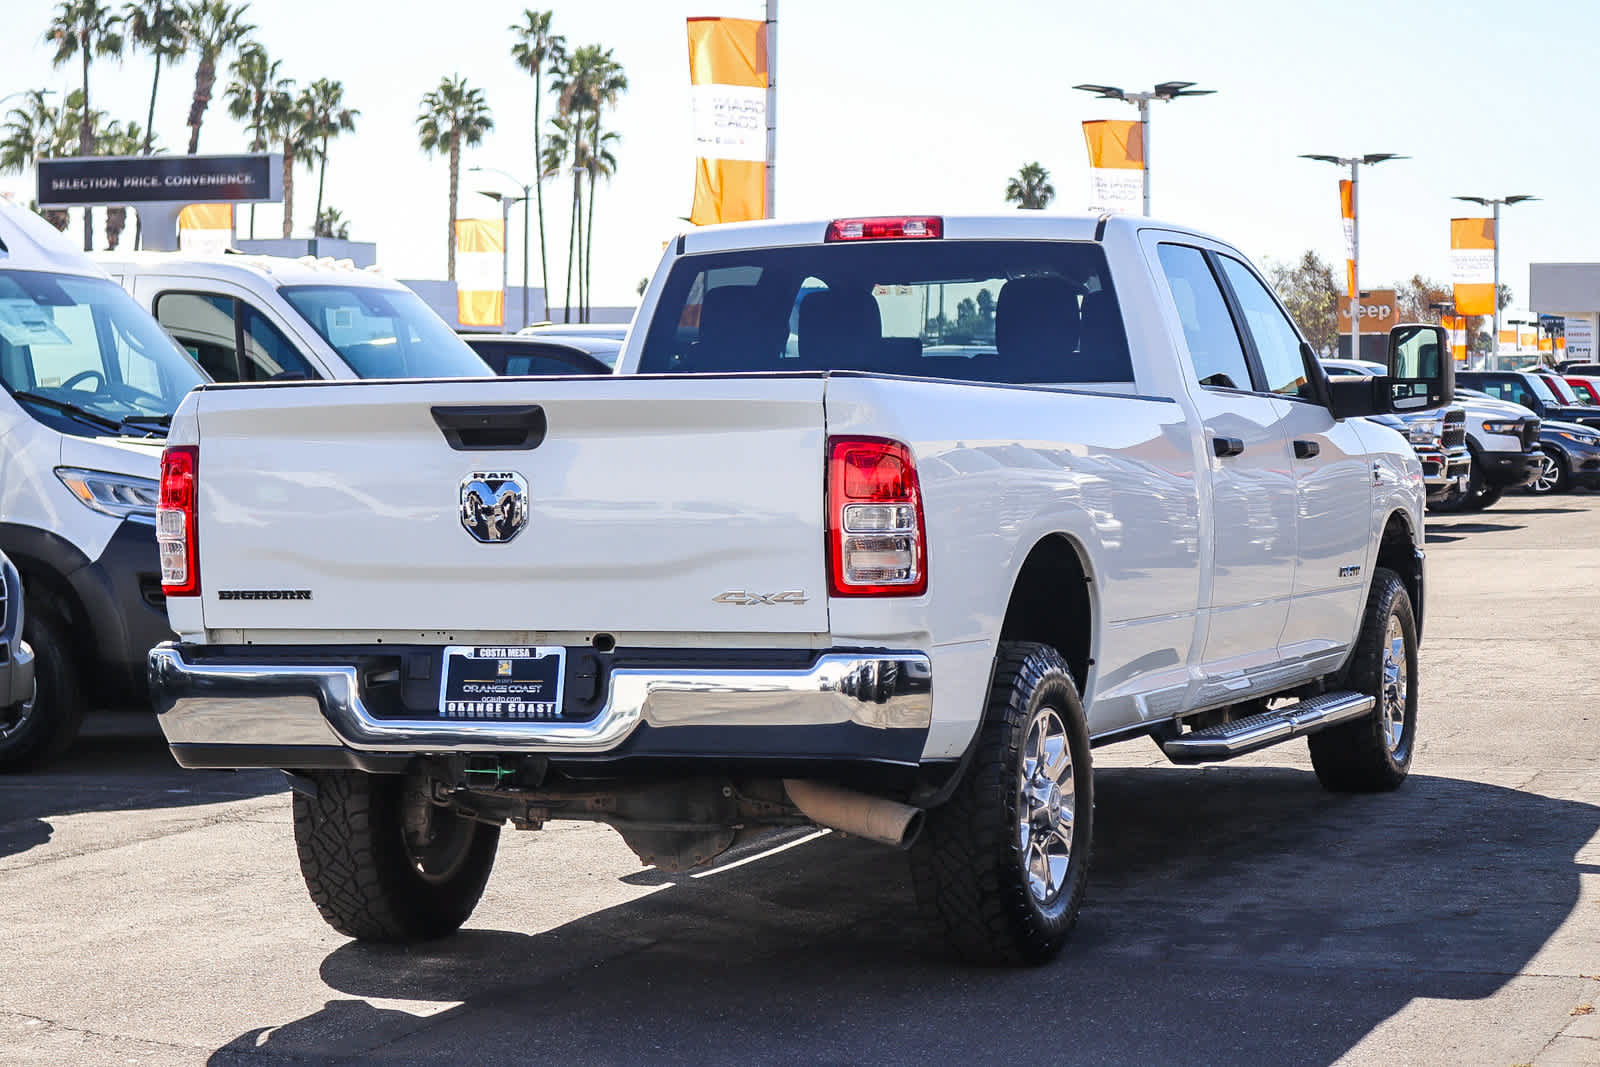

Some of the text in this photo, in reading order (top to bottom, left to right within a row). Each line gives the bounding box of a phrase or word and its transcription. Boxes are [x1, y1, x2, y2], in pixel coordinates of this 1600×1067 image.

[52, 174, 255, 190] SELECTION. PRICE. CONVENIENCE.
[480, 648, 530, 657] COSTA MESA
[463, 685, 542, 693] ORANGE COAST
[448, 703, 553, 713] ORANGE COAST
